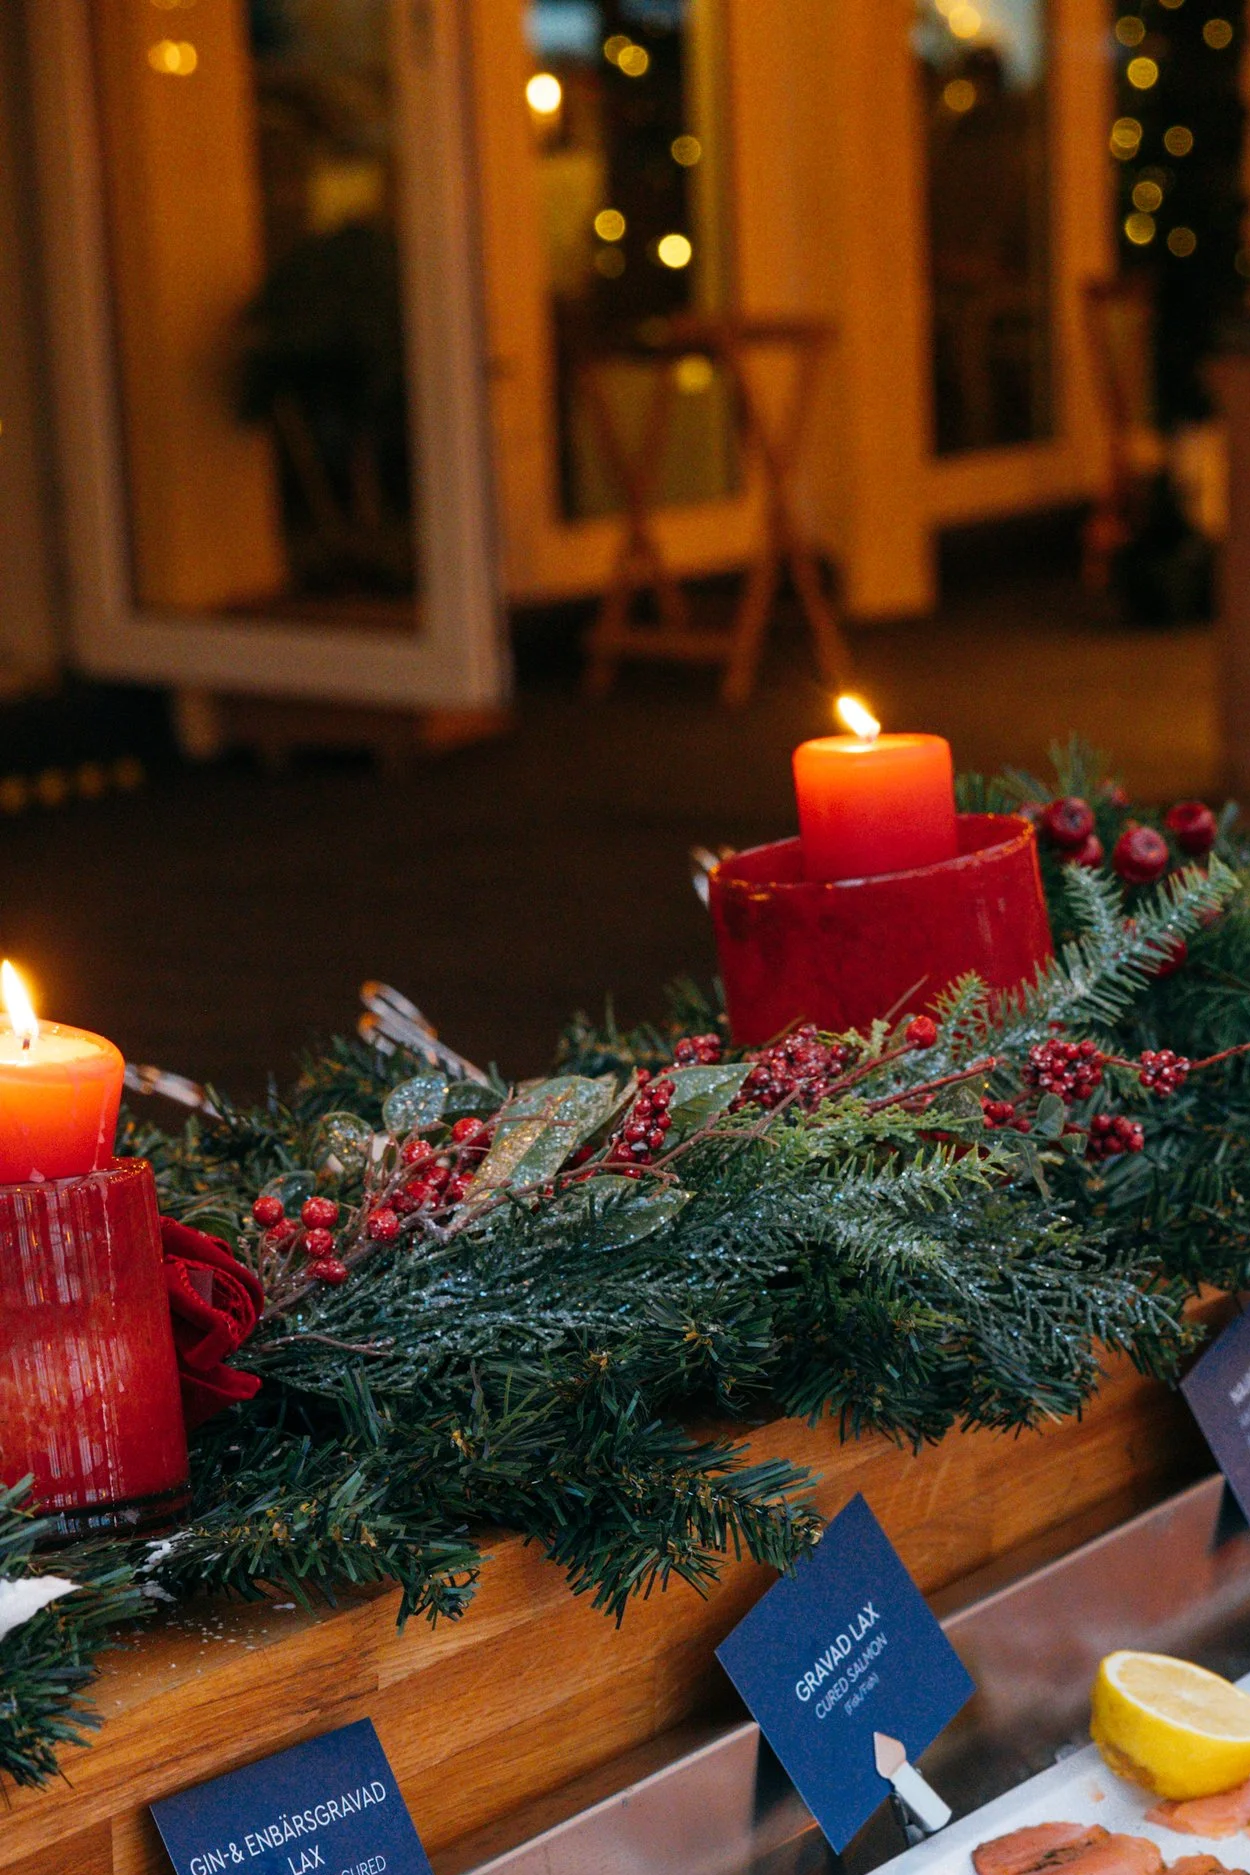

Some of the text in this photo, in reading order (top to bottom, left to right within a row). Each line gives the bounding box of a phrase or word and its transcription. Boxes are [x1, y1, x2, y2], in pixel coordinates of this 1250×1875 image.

[795, 1602, 881, 1702] GRAVAD LAX
[815, 1632, 888, 1720] CURED SALMON
[244, 1781, 387, 1857] ENBÄRSGRAVAD
